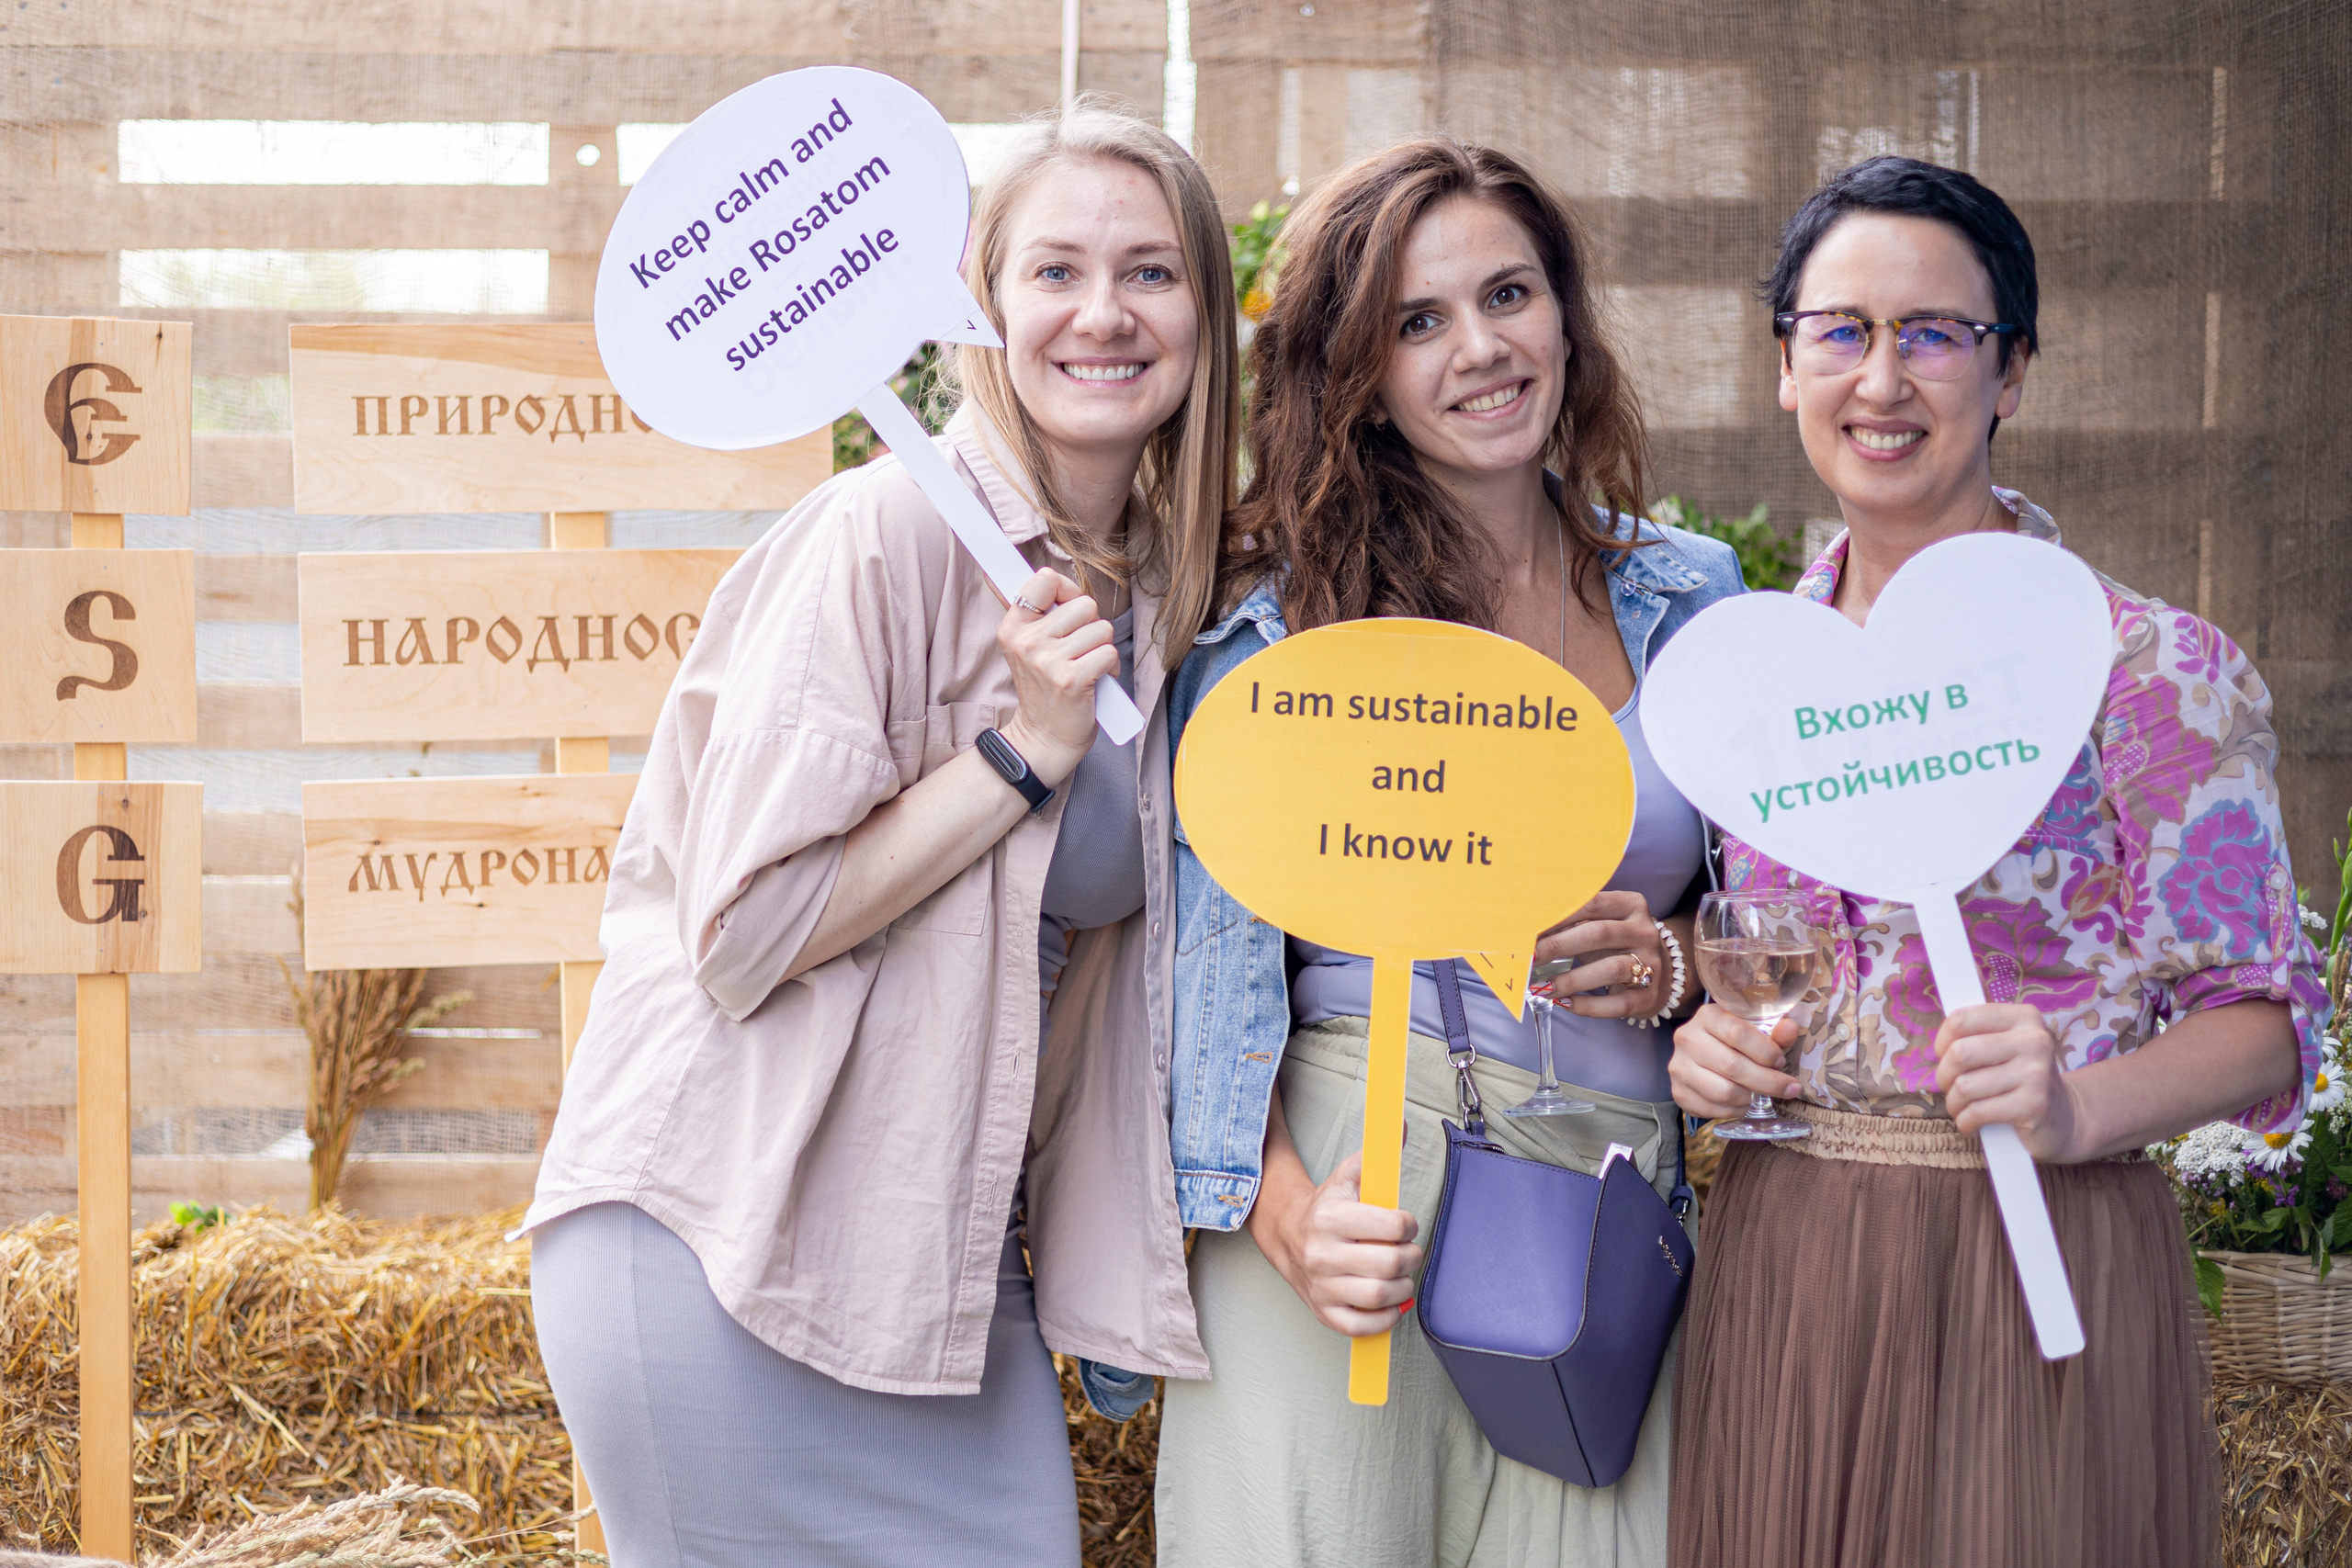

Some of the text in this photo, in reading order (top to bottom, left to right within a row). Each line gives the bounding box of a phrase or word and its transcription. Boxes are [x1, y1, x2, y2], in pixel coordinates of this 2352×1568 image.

[628, 97, 854, 289] Keep calm and
[665, 266, 752, 342] make
[748, 156, 891, 273] Rosatom
[726, 229, 899, 372] sustainable
[351, 393, 653, 444] ПРИРОДН
[56, 591, 139, 701] S
[1250, 681, 1578, 732] I am sustainable
[1794, 683, 1969, 739] Вхожу в
[1372, 760, 1446, 794] and
[1750, 739, 2041, 823] устойчивость
[56, 825, 145, 924] G
[1318, 823, 1493, 865] I know it
